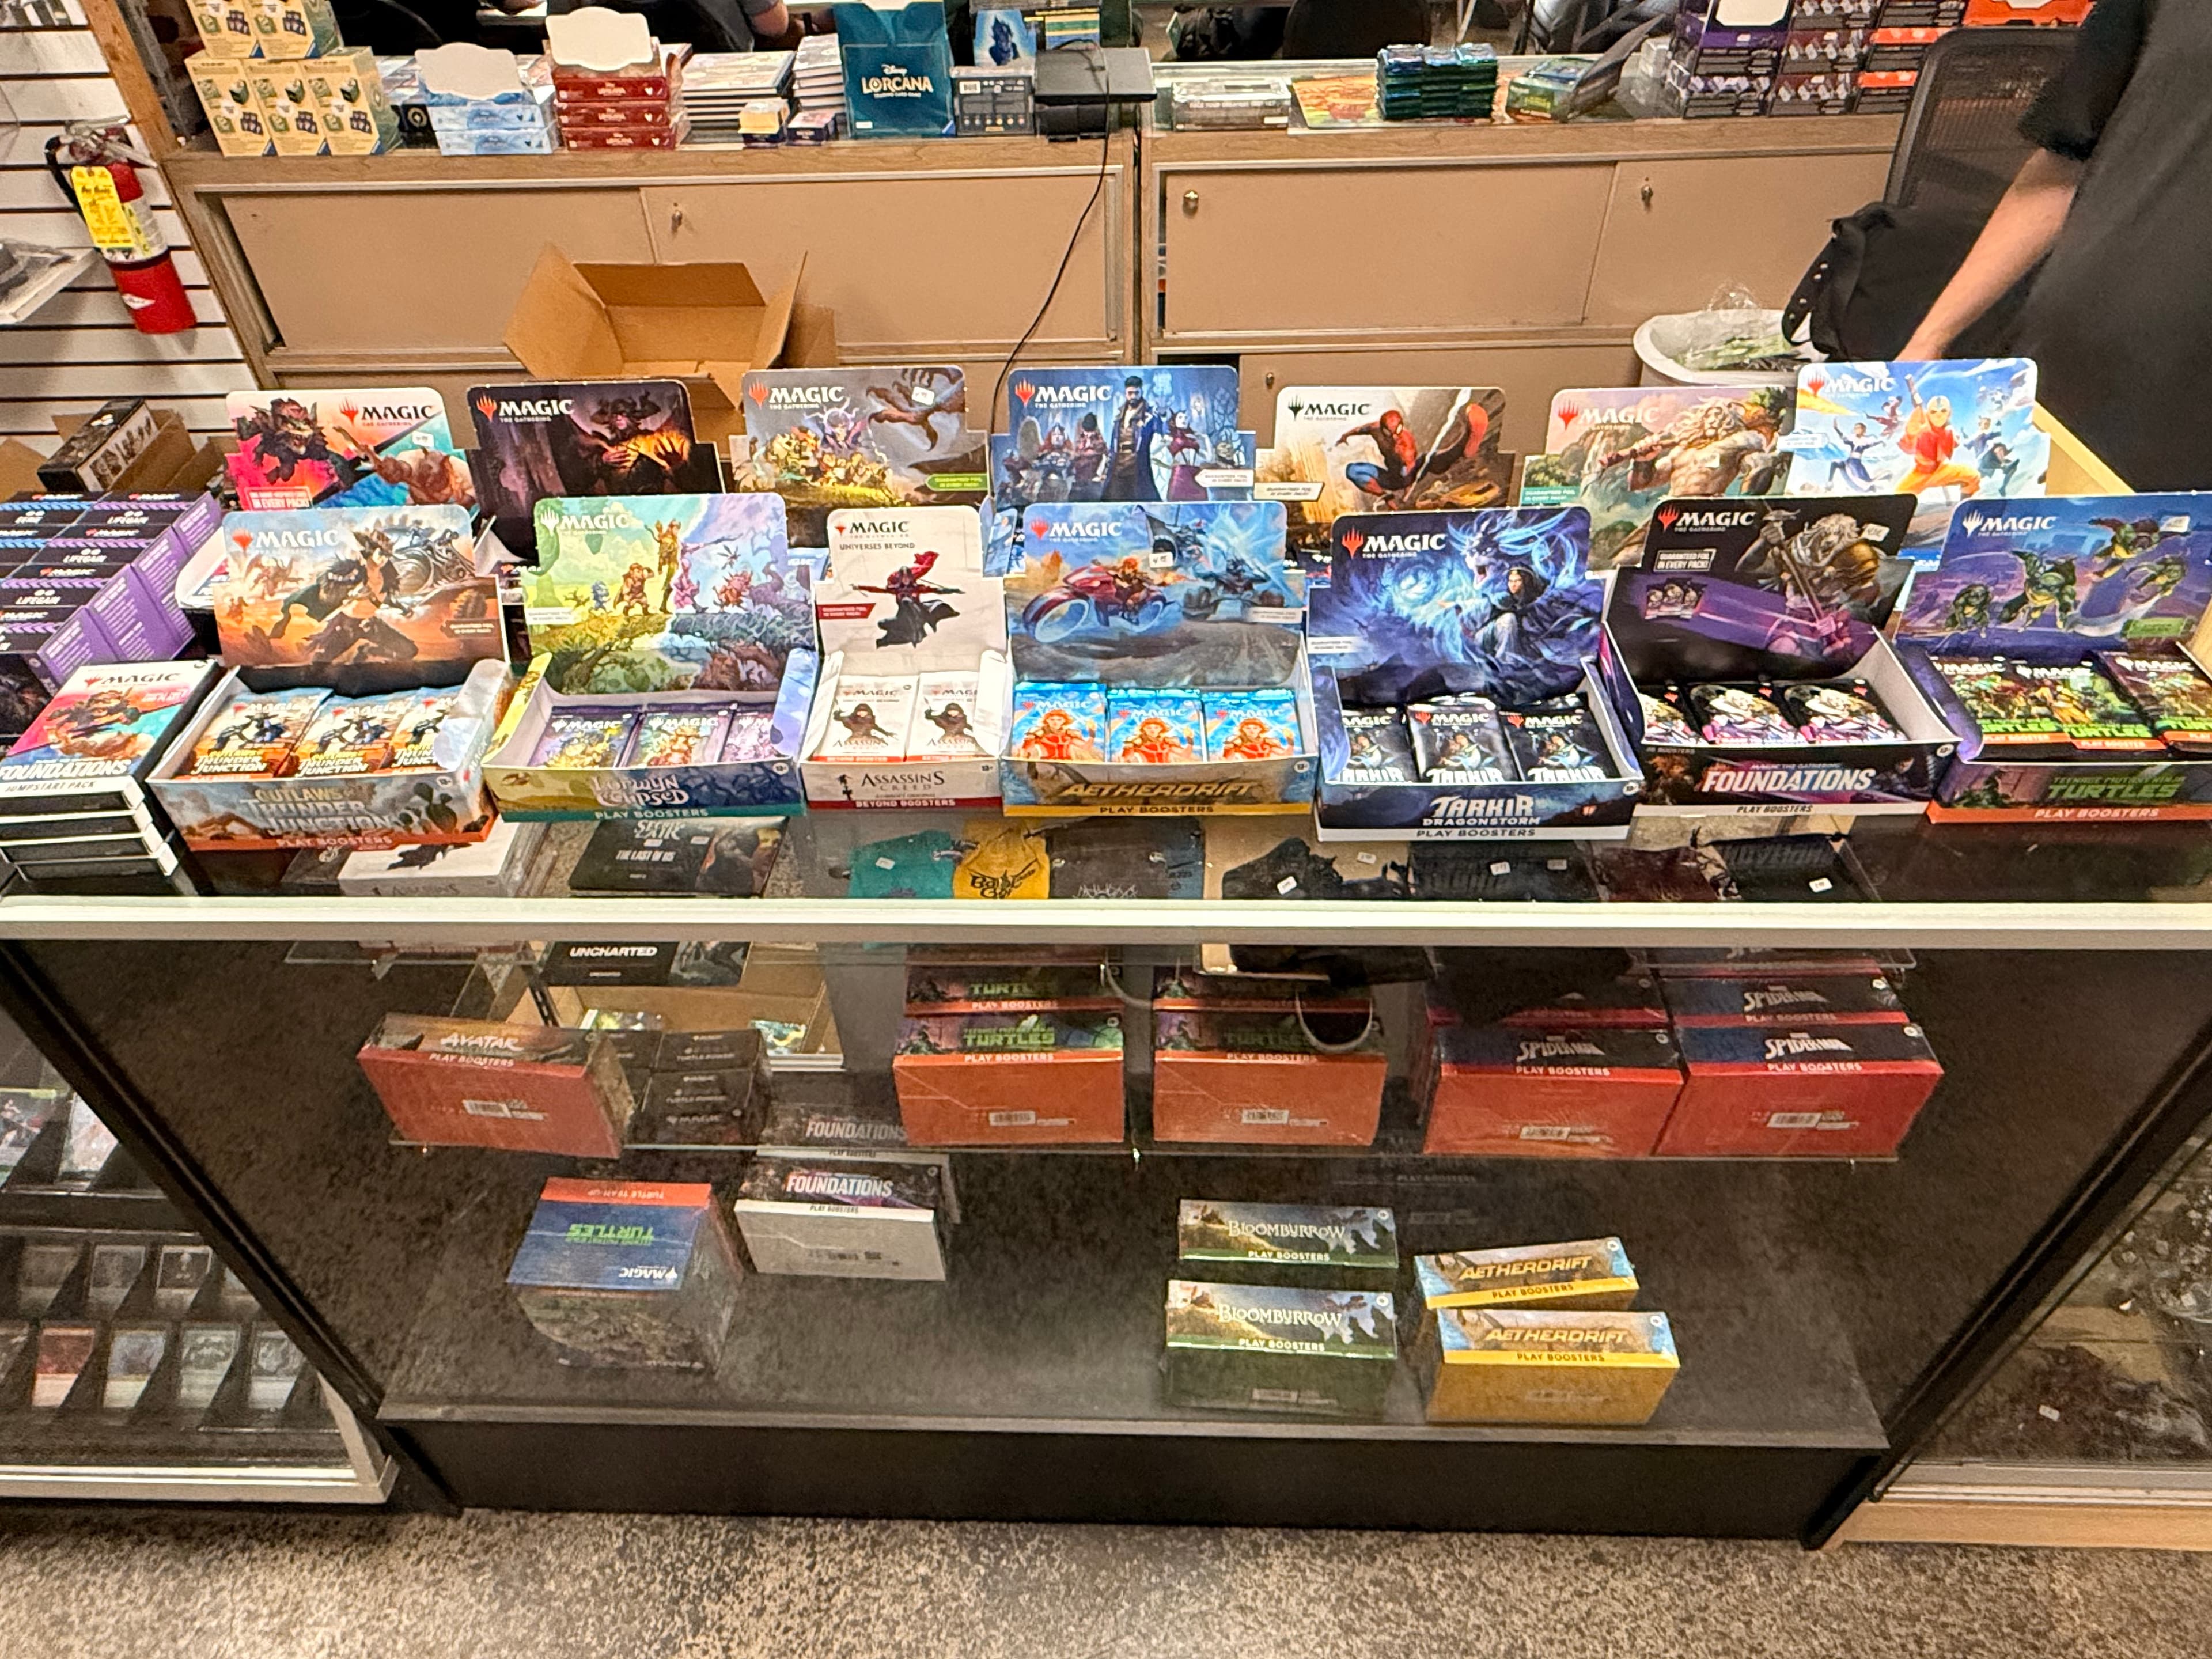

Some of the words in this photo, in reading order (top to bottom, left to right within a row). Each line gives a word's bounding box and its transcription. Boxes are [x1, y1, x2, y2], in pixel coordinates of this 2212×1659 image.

[861, 75, 934, 94] LORCANA
[1825, 376, 1896, 393] MAGIC
[768, 387, 845, 403] MAGIC
[1035, 385, 1112, 403] MAGIC
[362, 404, 434, 421] MAGIC
[499, 399, 575, 415] MAGIC
[1305, 403, 1372, 416] MAGIC
[1578, 406, 1659, 423] MAGIC
[560, 514, 631, 529] MAGIC
[1676, 510, 1757, 527] MAGIC
[1980, 516, 2057, 531] MAGIC
[850, 521, 910, 533] MAGIC
[1048, 521, 1122, 537] MAGIC
[256, 529, 339, 548] MAGIC
[1362, 533, 1446, 552] MAGIC
[1666, 561, 1687, 569] EVERY
[1944, 664, 2006, 675] MAGIC
[2033, 667, 2093, 678] MAGIC
[2135, 661, 2194, 672] MAGIC
[101, 673, 180, 685] MAGIC
[1039, 700, 1090, 709] MAGIC
[1131, 708, 1187, 718] MAGIC
[1229, 709, 1285, 718] MAGIC
[1432, 713, 1490, 725] MAGIC
[567, 720, 623, 730] MAGIC
[662, 717, 719, 728] MAGIC
[1525, 715, 1583, 727] MAGIC
[2065, 724, 2151, 737] TURTLES
[194, 756, 262, 765] THUNDER
[300, 759, 366, 768] THUNDER
[0, 760, 132, 781] FOUNDATIONS
[191, 763, 267, 774] JUNCTION
[296, 763, 369, 777] JUNCTION
[1426, 767, 1506, 783] TARKIR
[1527, 766, 1608, 782] TARKIR
[67, 780, 97, 790] PACK
[1702, 769, 1876, 792] FOUNDATIONS
[2054, 777, 2100, 785] TEENAGE
[255, 787, 343, 802] OUTLAWS
[1059, 782, 1255, 797] AETHERDRIFT
[2047, 784, 2183, 800] TURTLES
[240, 798, 369, 817] THUNDER
[855, 800, 897, 808] BEYOND
[900, 799, 956, 807] BOOSTERS
[1429, 794, 1534, 817] TARKIR
[1764, 805, 1813, 813] BOOSTERS
[595, 812, 628, 820] PLAY
[634, 809, 709, 819] BOOSTERS
[1100, 806, 1134, 815] PLAY
[1139, 806, 1214, 814] BOOSTERS
[2034, 809, 2073, 820] PLAY
[2076, 808, 2160, 819] BOOSTERS
[267, 815, 395, 836] JUNCTION
[1422, 816, 1540, 827] DRAGONSTORM
[1417, 830, 1455, 838] PLAY
[1458, 828, 1536, 838] BOOSTERS
[317, 835, 393, 848] BOOSTERS
[630, 850, 650, 861] LAST
[570, 946, 658, 957] UNCHARTED
[971, 1001, 998, 1010] PLAY
[1001, 1000, 1058, 1009] BOOSTERS
[1745, 1014, 1774, 1024] PLAY
[1777, 1012, 1838, 1022] BOOSTERS
[440, 1032, 525, 1051] AVATAR
[964, 1033, 1056, 1047] TURTLES
[429, 1052, 460, 1064] PLAY
[460, 1054, 514, 1067] BOOSTERS
[964, 1054, 993, 1063] PLAY
[995, 1052, 1054, 1063] BOOSTERS
[1227, 1053, 1260, 1061] PLAY
[1263, 1053, 1317, 1062] BOOSTERS
[1516, 1066, 1544, 1075] PLAY
[1548, 1066, 1611, 1077] BOOSTERS
[1768, 1062, 1796, 1073] PLAY
[1799, 1062, 1862, 1072] BOOSTERS
[805, 1120, 907, 1141] FOUNDATIONS
[787, 1174, 894, 1198] FOUNDATIONS
[810, 1205, 825, 1213] PLAY
[568, 1223, 655, 1238] TURTLES
[1228, 1219, 1346, 1238] BLOOMBURROW
[1248, 1250, 1274, 1259] PLAY
[1276, 1251, 1330, 1261] BOOSTERS
[618, 1267, 666, 1279] MAGIC
[1459, 1255, 1593, 1281] AETHERDRIFT
[1492, 1289, 1518, 1300] PLAY
[1521, 1283, 1574, 1296] BOOSTERS
[1218, 1303, 1343, 1327] BLOOMBURROW
[1484, 1327, 1630, 1343] AETHERDRIFT
[1238, 1338, 1267, 1347] PLAY
[1268, 1339, 1325, 1352] BOOSTERS
[1517, 1353, 1544, 1362] PLAY
[1547, 1353, 1605, 1362] BOOSTERS
